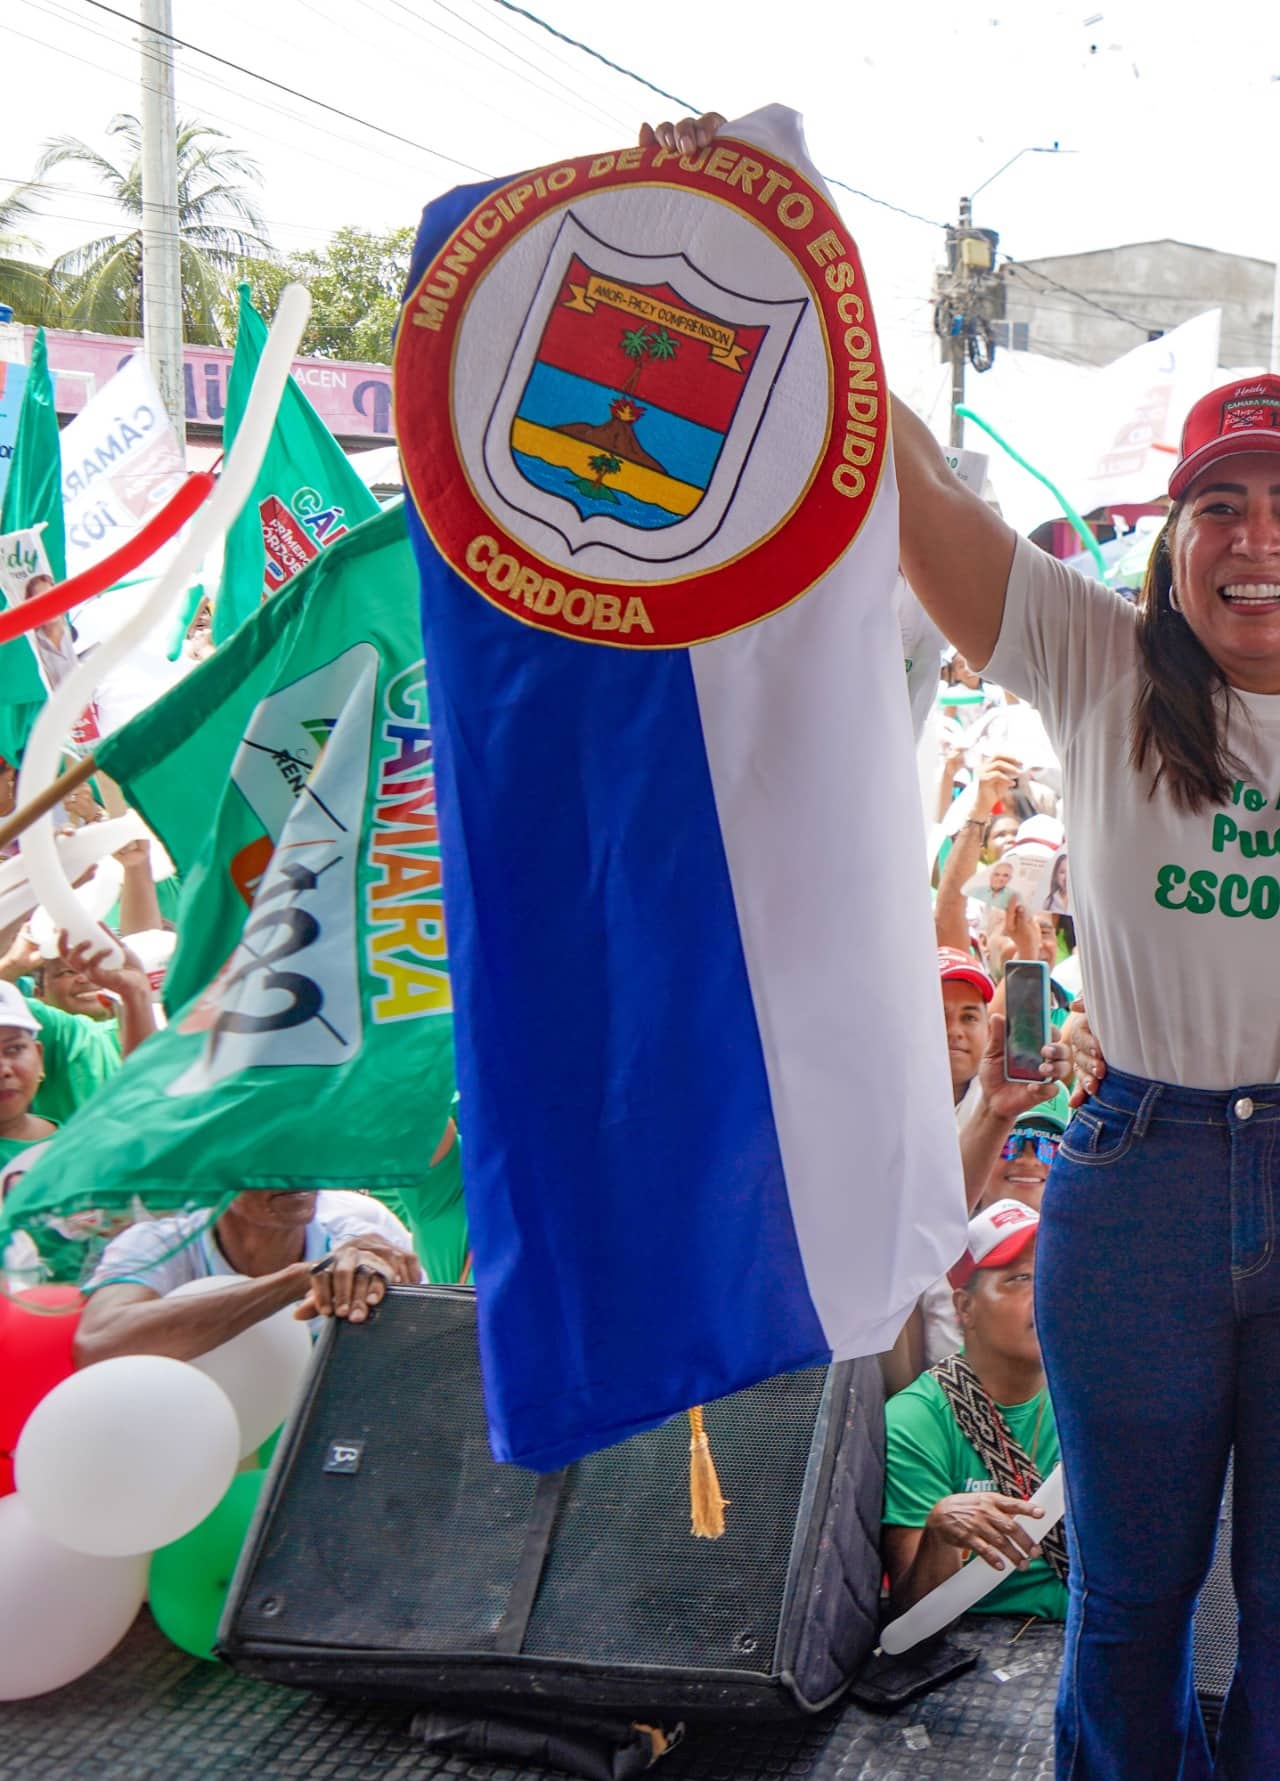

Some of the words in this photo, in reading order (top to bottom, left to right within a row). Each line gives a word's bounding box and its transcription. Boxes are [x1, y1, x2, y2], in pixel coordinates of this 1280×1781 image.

[412, 167, 577, 332] MUNICIPIO
[588, 147, 647, 178] DE
[651, 145, 814, 230] PUERTO
[806, 230, 878, 499] ESCONDIDO
[465, 535, 654, 634] CORDOBA
